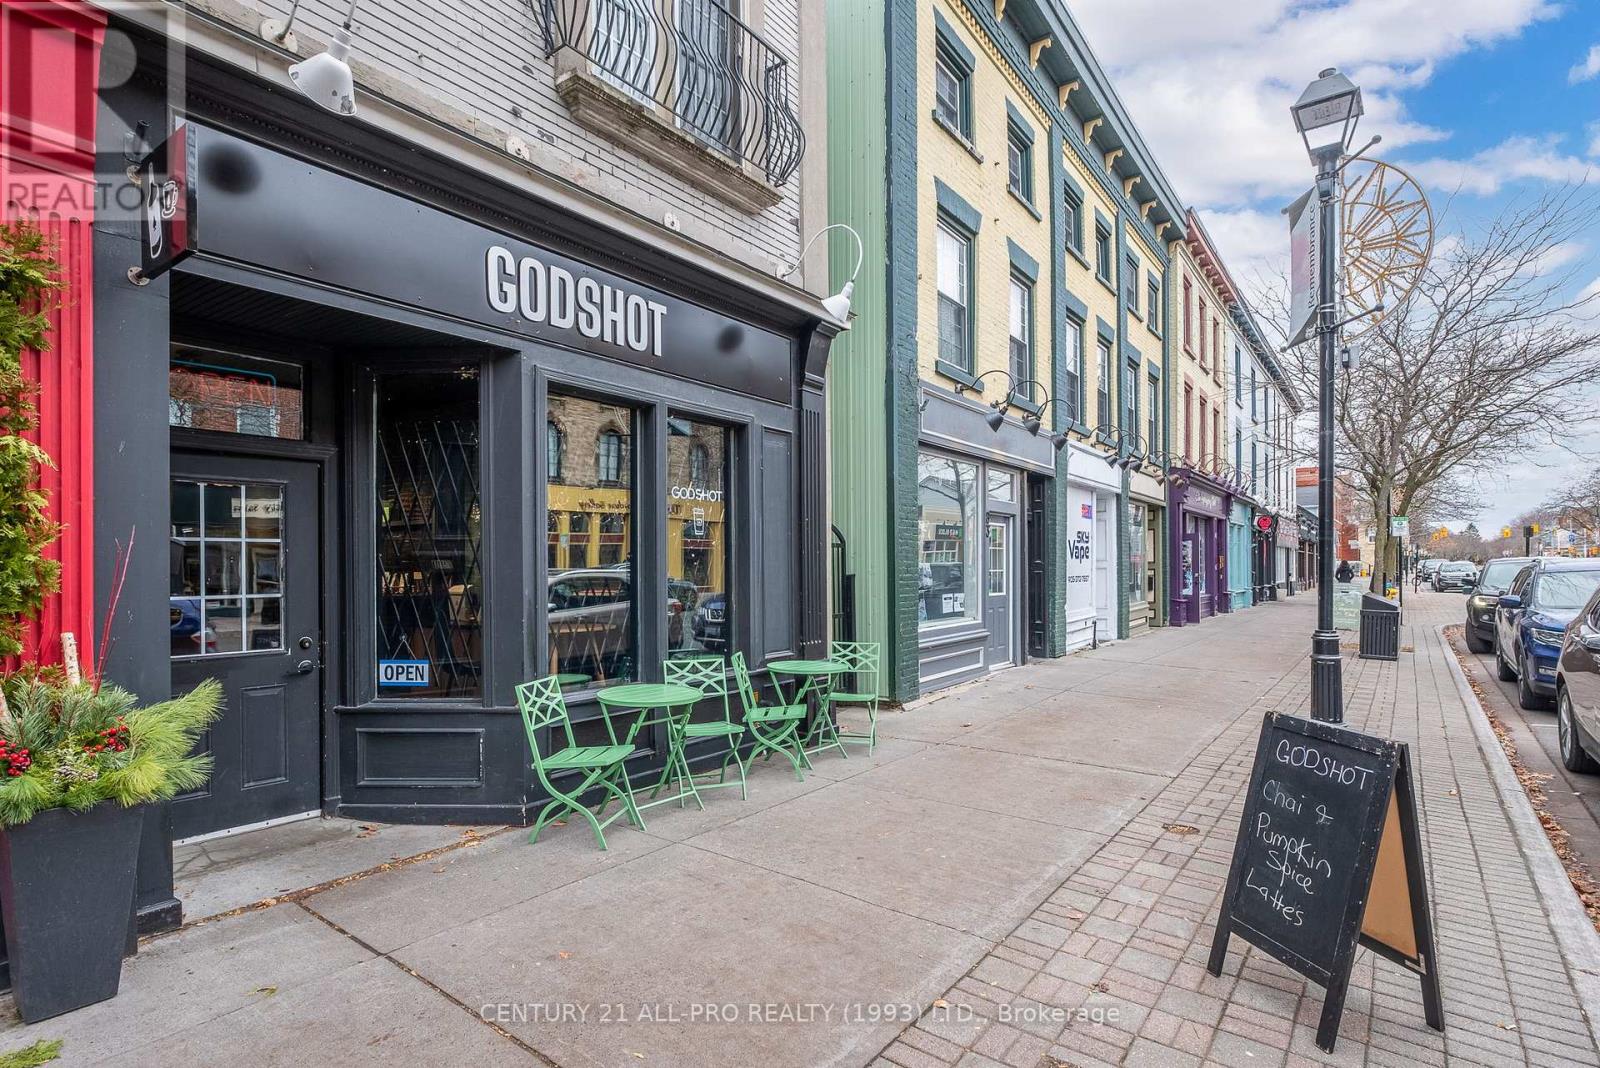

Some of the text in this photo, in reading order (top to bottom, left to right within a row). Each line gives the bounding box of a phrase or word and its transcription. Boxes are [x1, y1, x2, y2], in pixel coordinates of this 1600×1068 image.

[1308, 203, 1316, 309] Remembrance
[486, 245, 667, 357] GODSHOT
[671, 486, 722, 502] GODSHOT
[1068, 539, 1089, 564] Vape
[384, 665, 424, 681] OPEN
[1276, 739, 1374, 791] GODSHOT
[1263, 780, 1305, 815] Chai
[1266, 850, 1314, 894] Spice
[1246, 867, 1304, 926] Lattes
